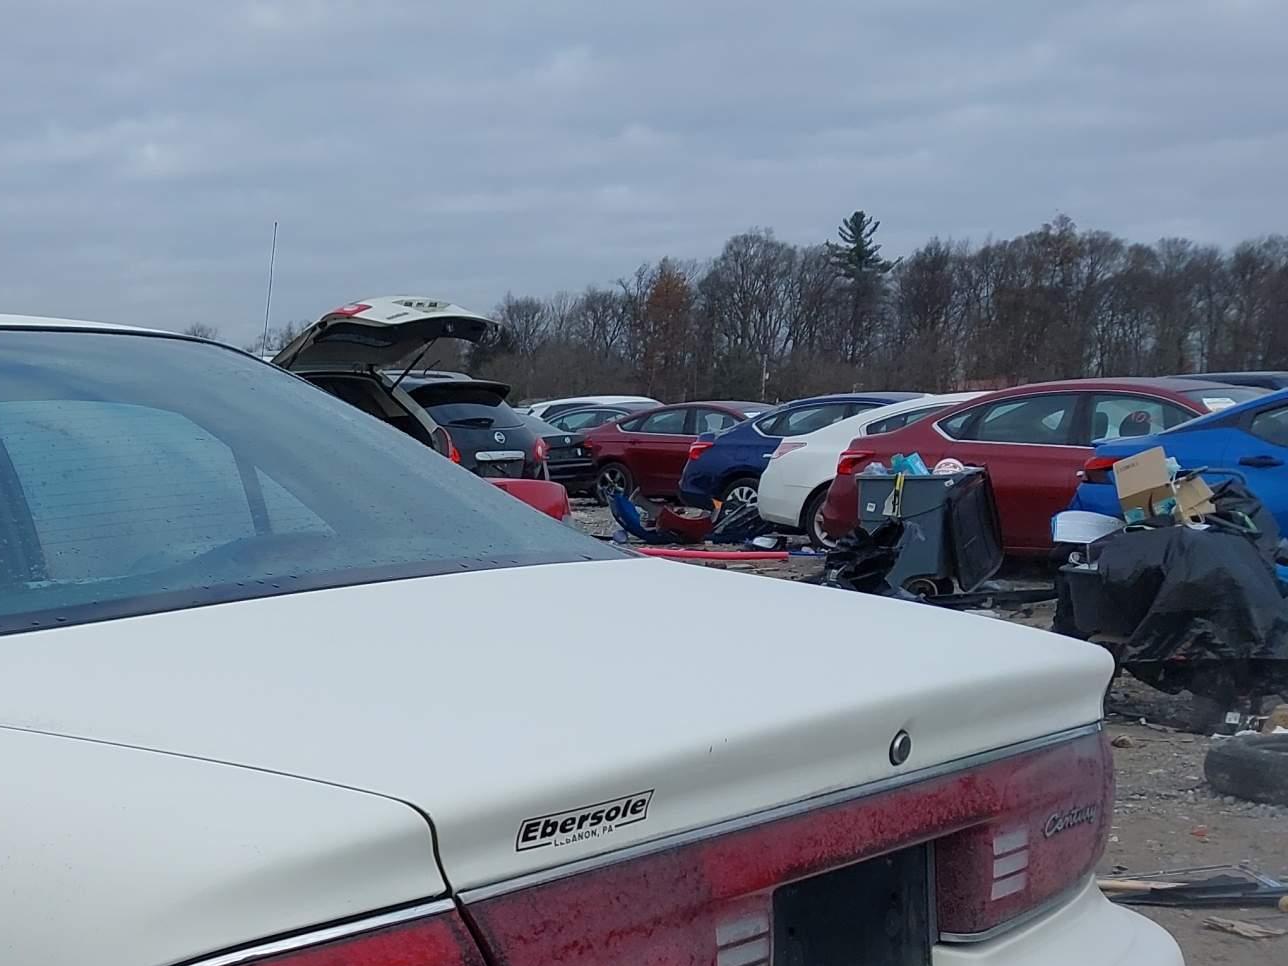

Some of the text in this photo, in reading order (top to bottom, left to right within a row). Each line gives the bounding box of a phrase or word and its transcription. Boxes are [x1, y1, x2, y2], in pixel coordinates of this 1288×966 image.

[521, 798, 647, 843] Ebersole
[602, 824, 614, 836] PA
[1044, 805, 1096, 837] Century
